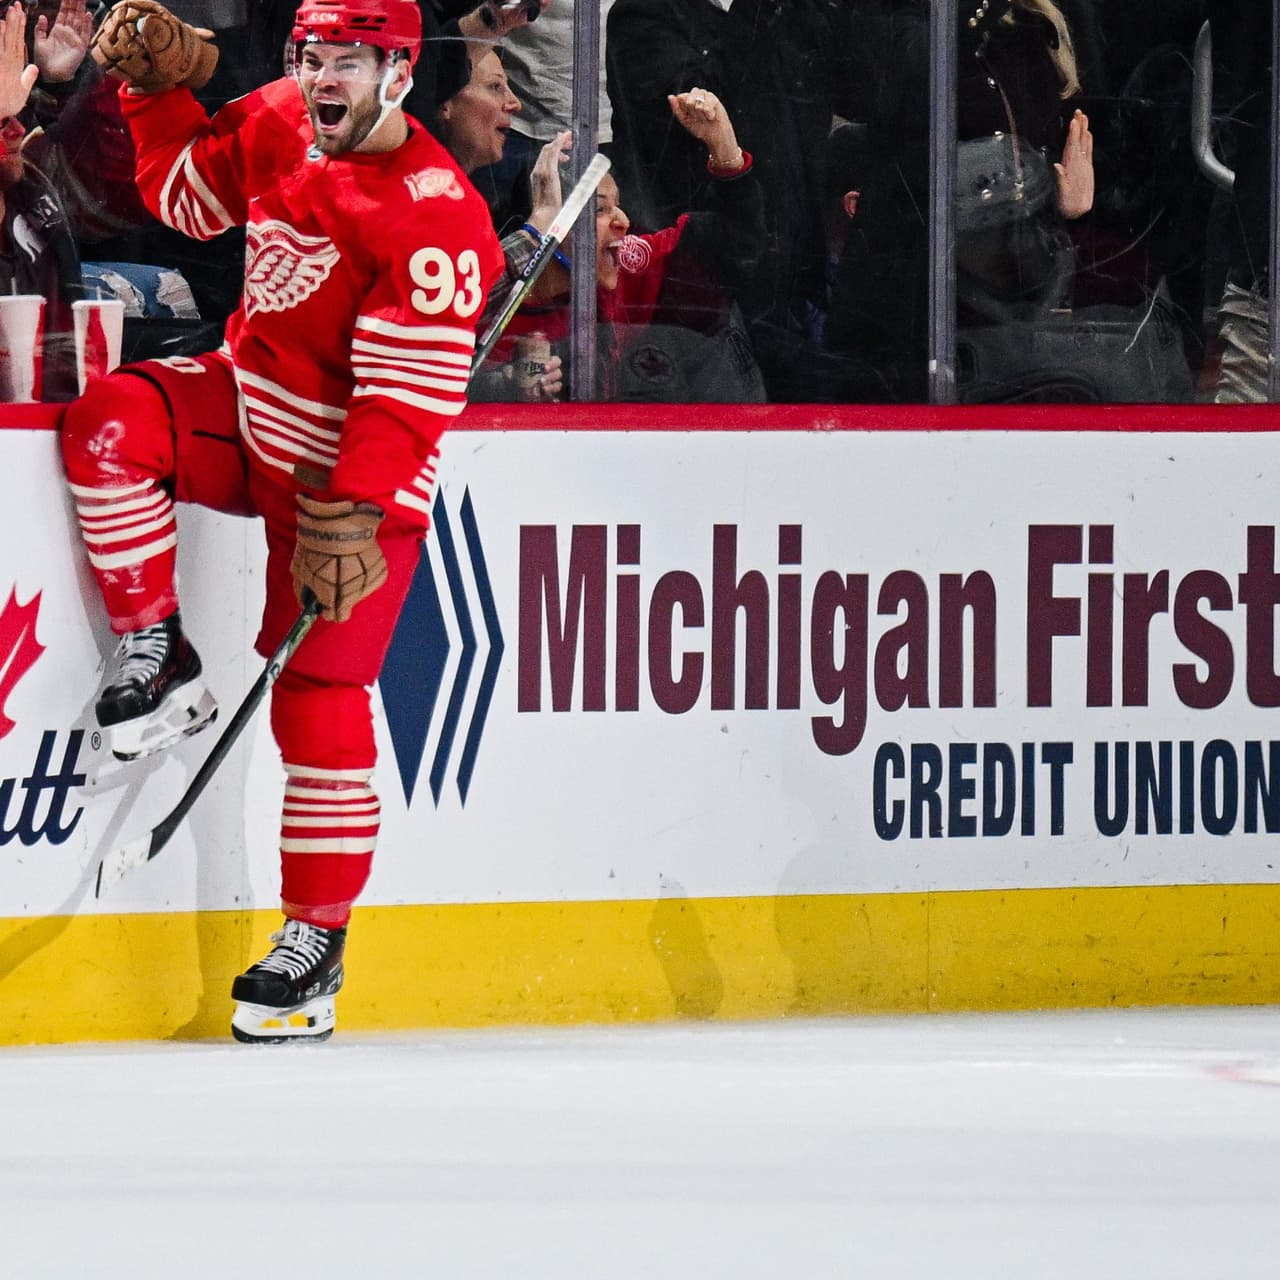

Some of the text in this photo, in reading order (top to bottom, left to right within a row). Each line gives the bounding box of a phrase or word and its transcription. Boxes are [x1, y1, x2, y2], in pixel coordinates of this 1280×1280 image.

[408, 246, 482, 318] 93
[517, 524, 998, 757] Michigan
[872, 741, 1074, 842] CREDIT
